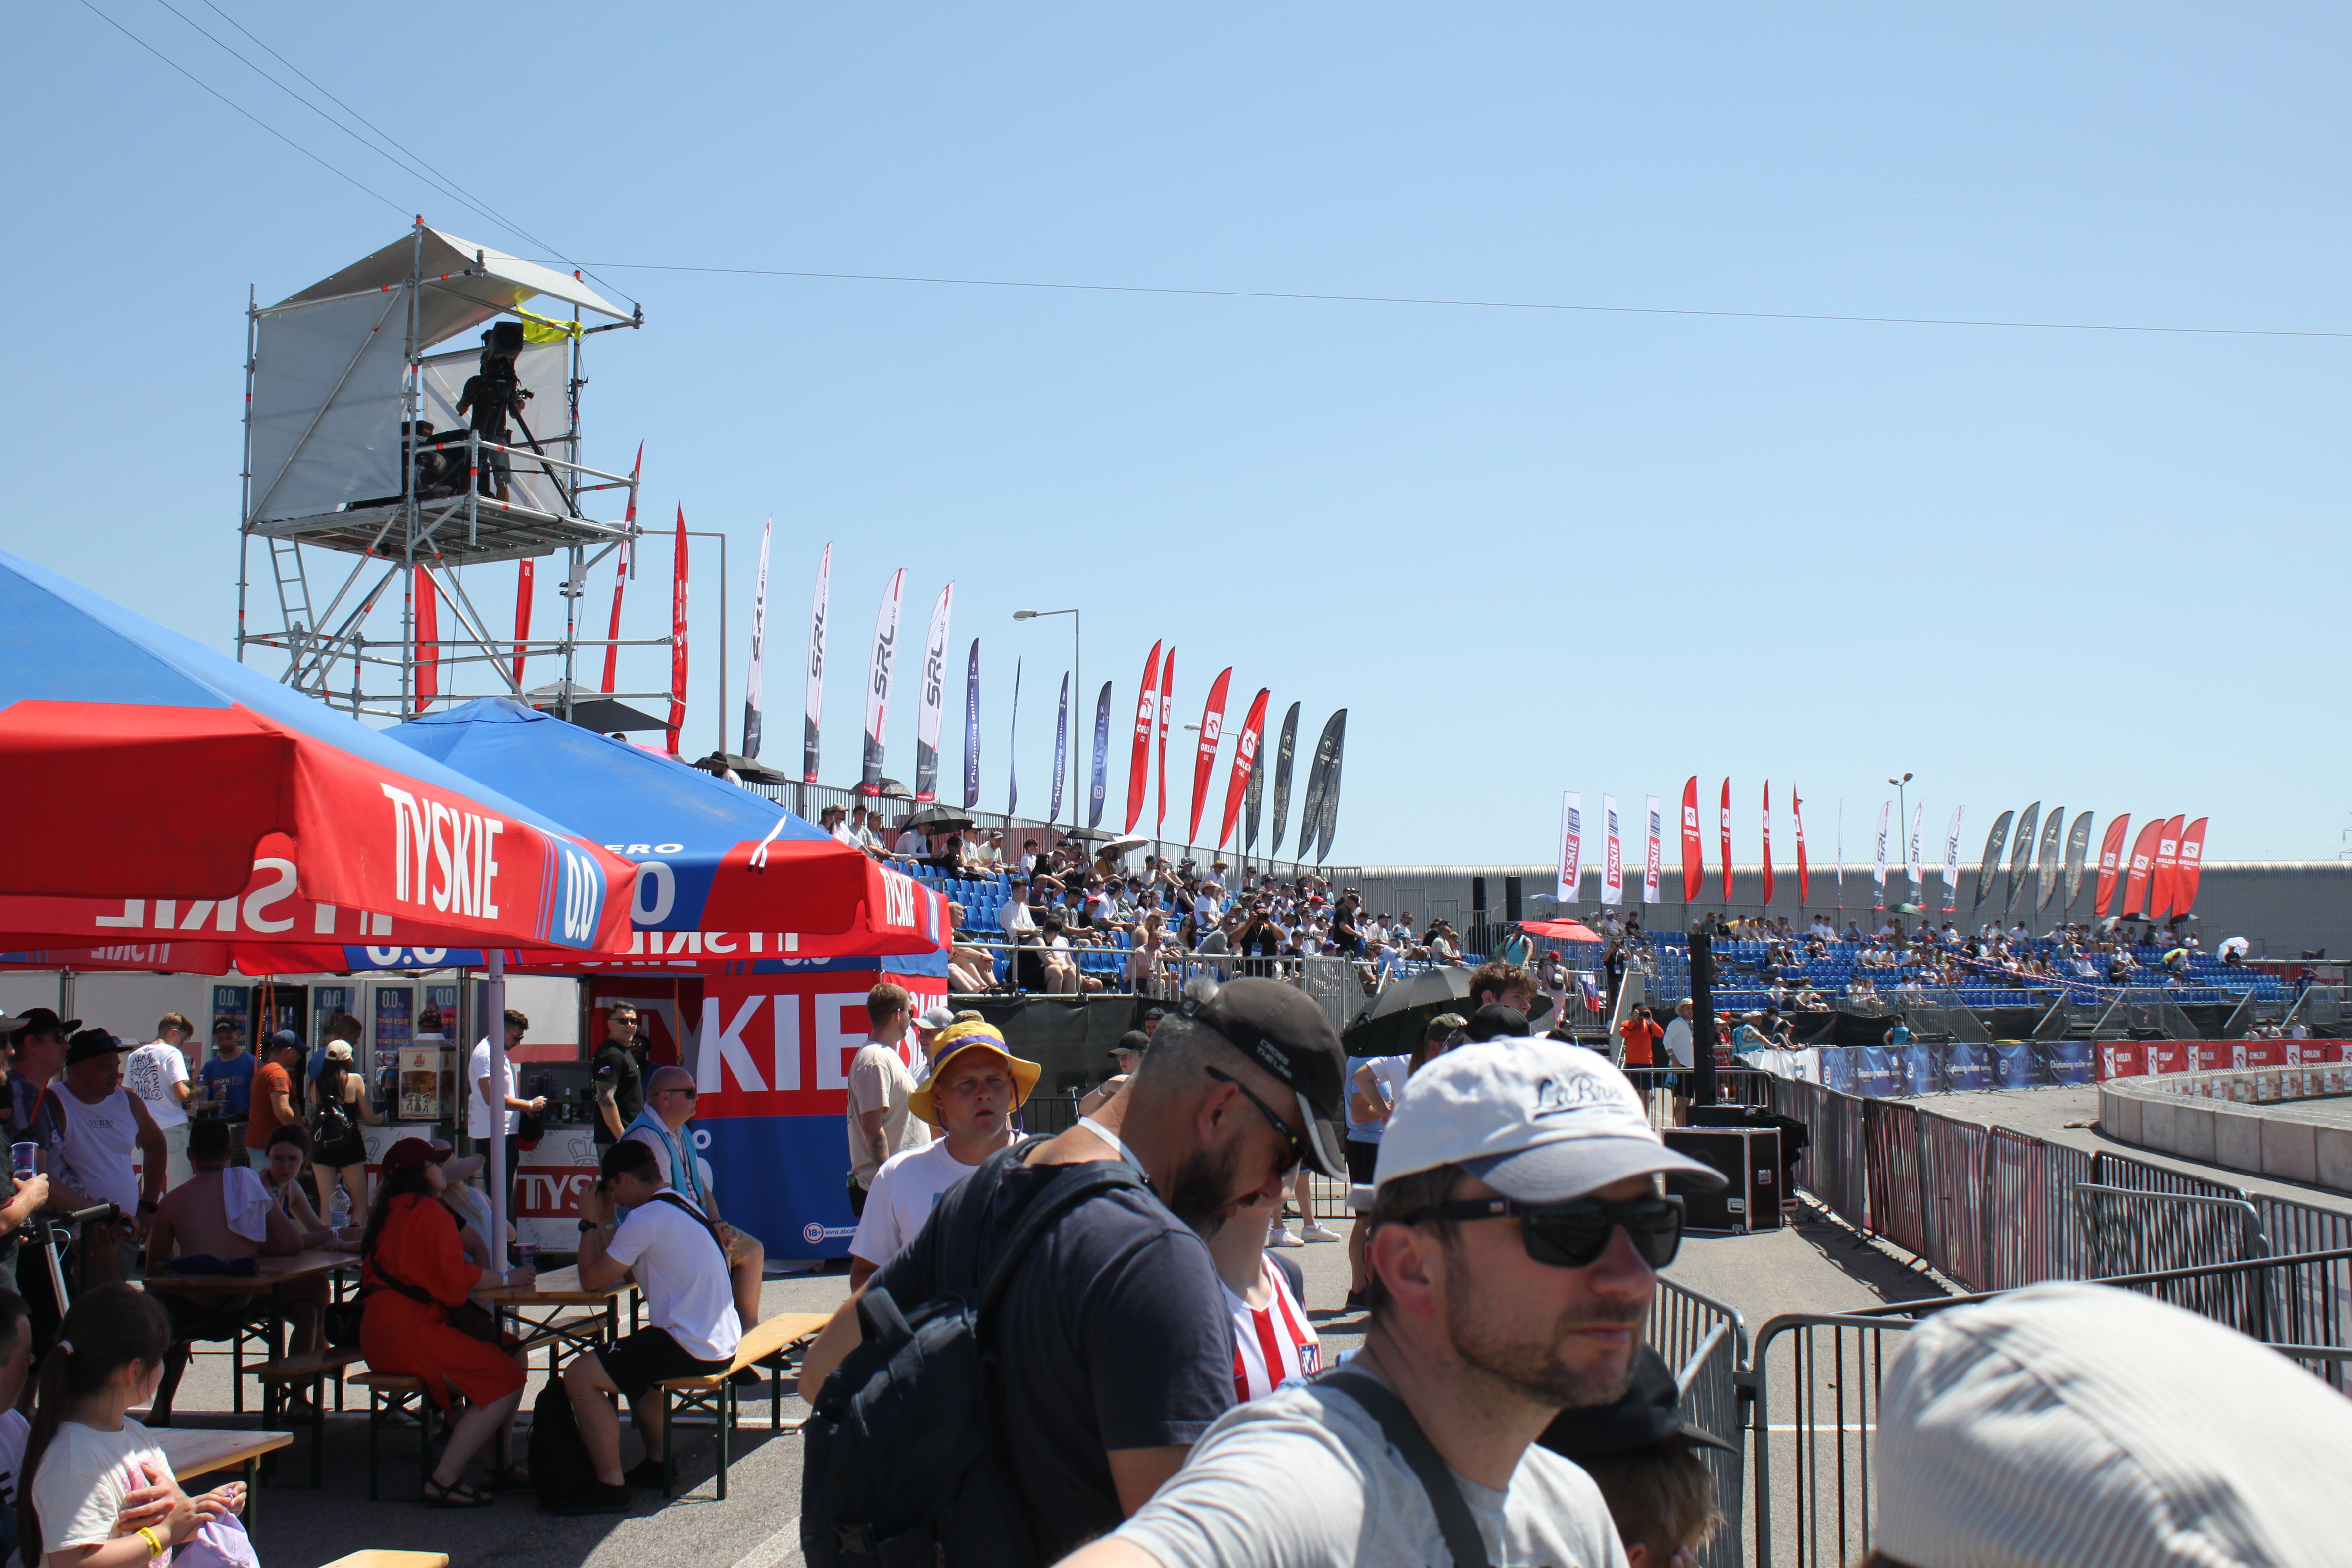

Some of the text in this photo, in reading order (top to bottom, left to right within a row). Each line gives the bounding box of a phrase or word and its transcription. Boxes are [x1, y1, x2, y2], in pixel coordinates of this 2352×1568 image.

[1200, 743, 1217, 754] ORLEN
[1236, 757, 1252, 772] ORLEN
[1684, 829, 1699, 837] ORLEN
[605, 843, 684, 854] ERO
[380, 782, 503, 920] TYSKIE
[564, 849, 598, 941] 0.0
[1564, 838, 1577, 881] TYSKIE
[1609, 840, 1618, 882] TYSKIE
[1648, 840, 1659, 882] TYSKIE
[880, 867, 917, 929] TYSKIE
[219, 989, 235, 1006] 0.0
[323, 990, 341, 1007] 0.0
[382, 990, 398, 1008] 0.0
[436, 988, 453, 1006] 0.0
[2116, 1053, 2131, 1062] ORLEN
